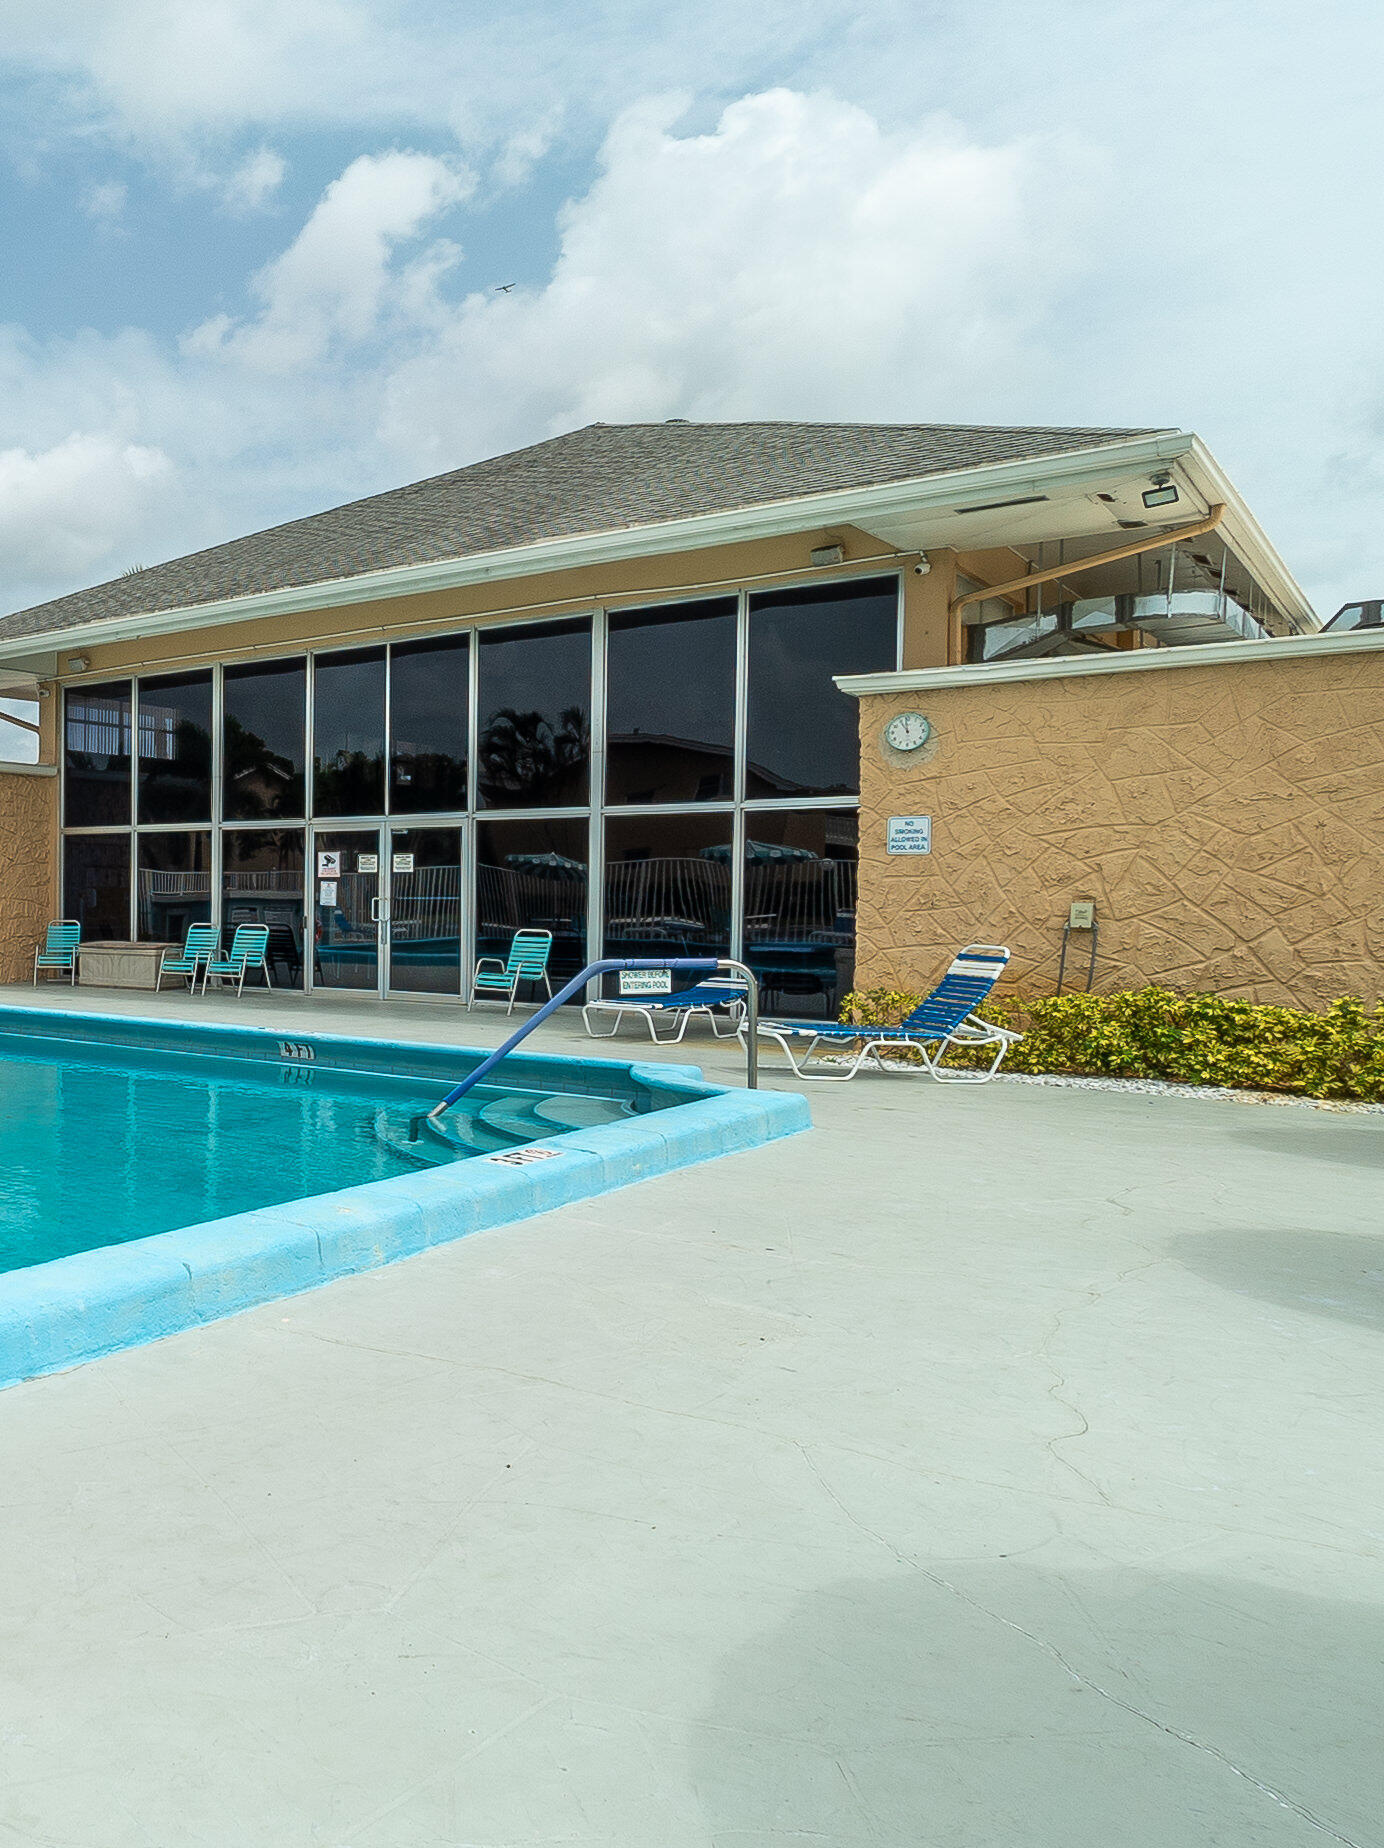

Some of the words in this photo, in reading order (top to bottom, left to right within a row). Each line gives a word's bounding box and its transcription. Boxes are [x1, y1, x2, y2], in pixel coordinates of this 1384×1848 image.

[621, 971, 646, 979] SHOWER
[622, 981, 652, 989] ENTERING
[652, 980, 669, 988] POOL
